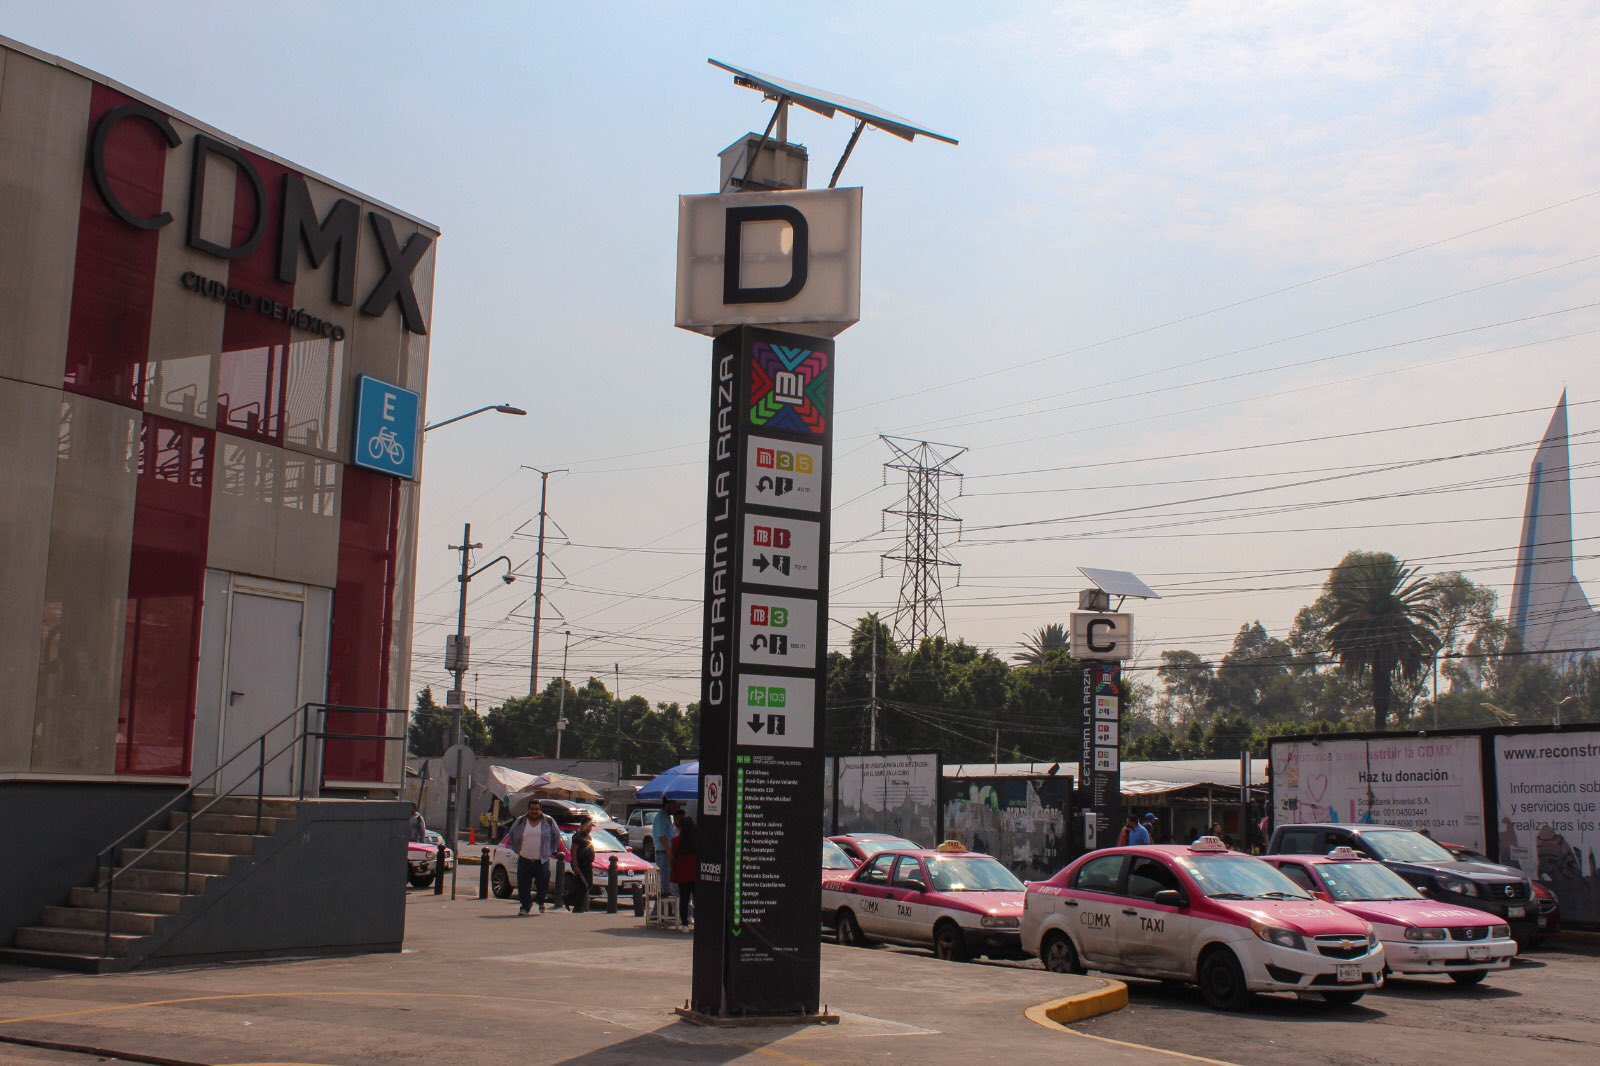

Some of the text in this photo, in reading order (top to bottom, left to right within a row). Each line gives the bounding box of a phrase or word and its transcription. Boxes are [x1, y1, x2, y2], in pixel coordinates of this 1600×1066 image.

[93, 105, 432, 336] CDMX
[723, 205, 808, 304] D
[180, 270, 346, 342] CIUDAD DE MÉXICO
[383, 392, 397, 422] E
[709, 354, 734, 706] CETRAM LA RAZA
[1087, 618, 1116, 653] C
[769, 692, 785, 702] 103
[1083, 668, 1091, 786] CETRAM LA RAZA
[1503, 744, 1600, 760] www.reconstr
[1358, 769, 1448, 783] Haz tu donación
[1510, 781, 1576, 794] Información
[1357, 798, 1391, 806] Scoabank
[1510, 800, 1596, 816] y servicios que
[1552, 819, 1574, 831] tras
[1577, 819, 1595, 831] los
[860, 899, 912, 917] CDMX TAXI
[1080, 911, 1164, 932] CDMX TAXI
